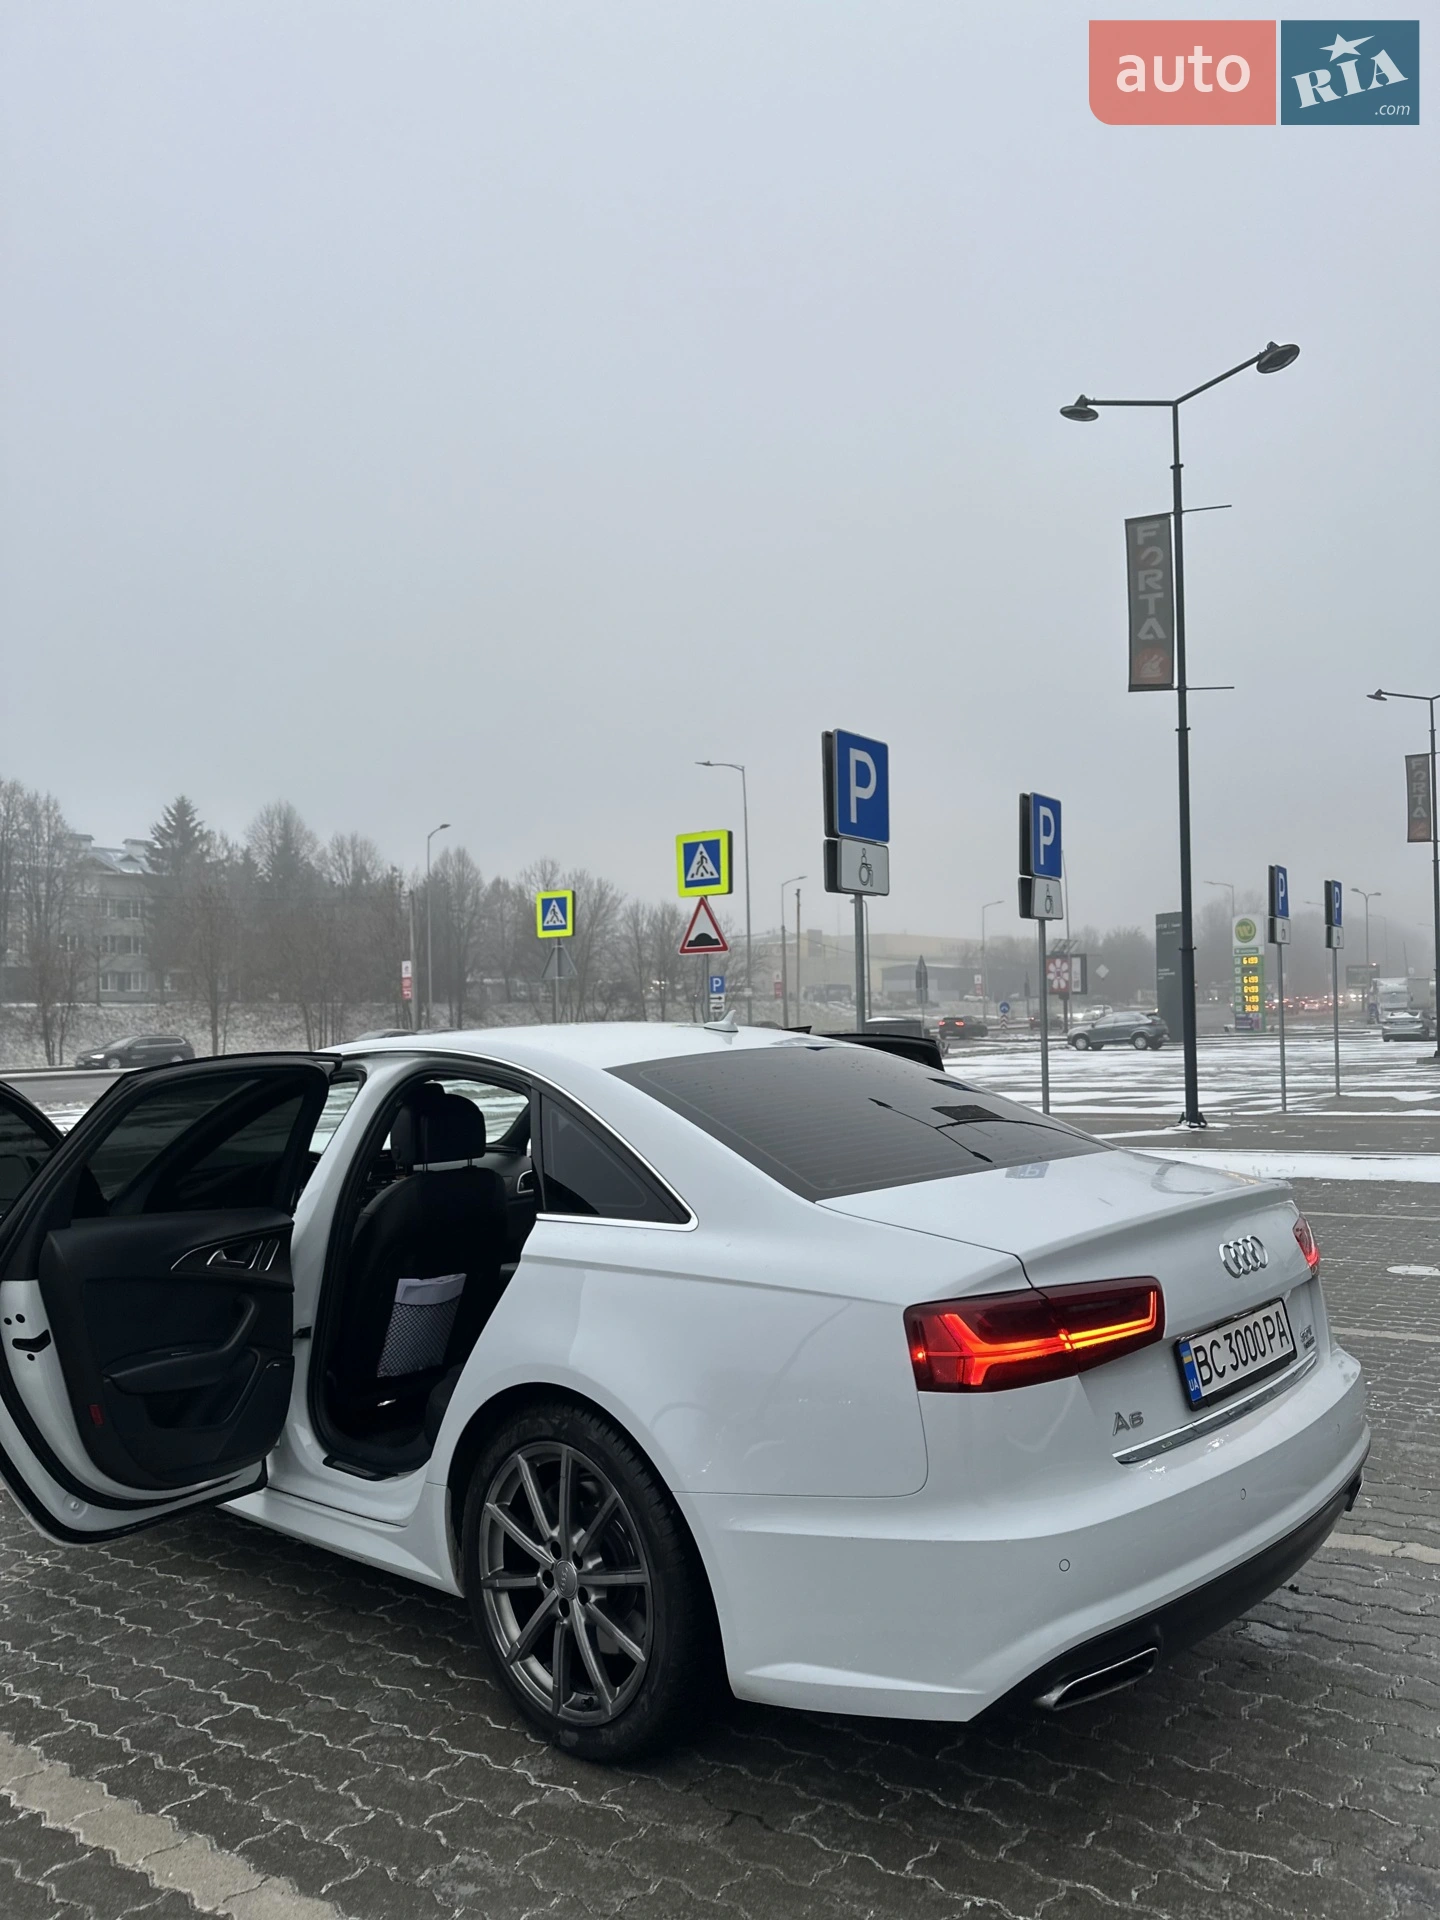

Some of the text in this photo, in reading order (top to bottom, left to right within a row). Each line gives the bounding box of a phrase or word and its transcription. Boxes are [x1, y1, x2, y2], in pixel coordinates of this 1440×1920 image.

[1136, 523, 1167, 640] FORTA
[850, 747, 877, 823] P
[1039, 805, 1055, 865] P
[1278, 872, 1285, 911] P
[1334, 886, 1341, 920] P
[712, 977, 722, 992] P
[1188, 1378, 1200, 1392] UA
[1112, 1411, 1144, 1437] A6
